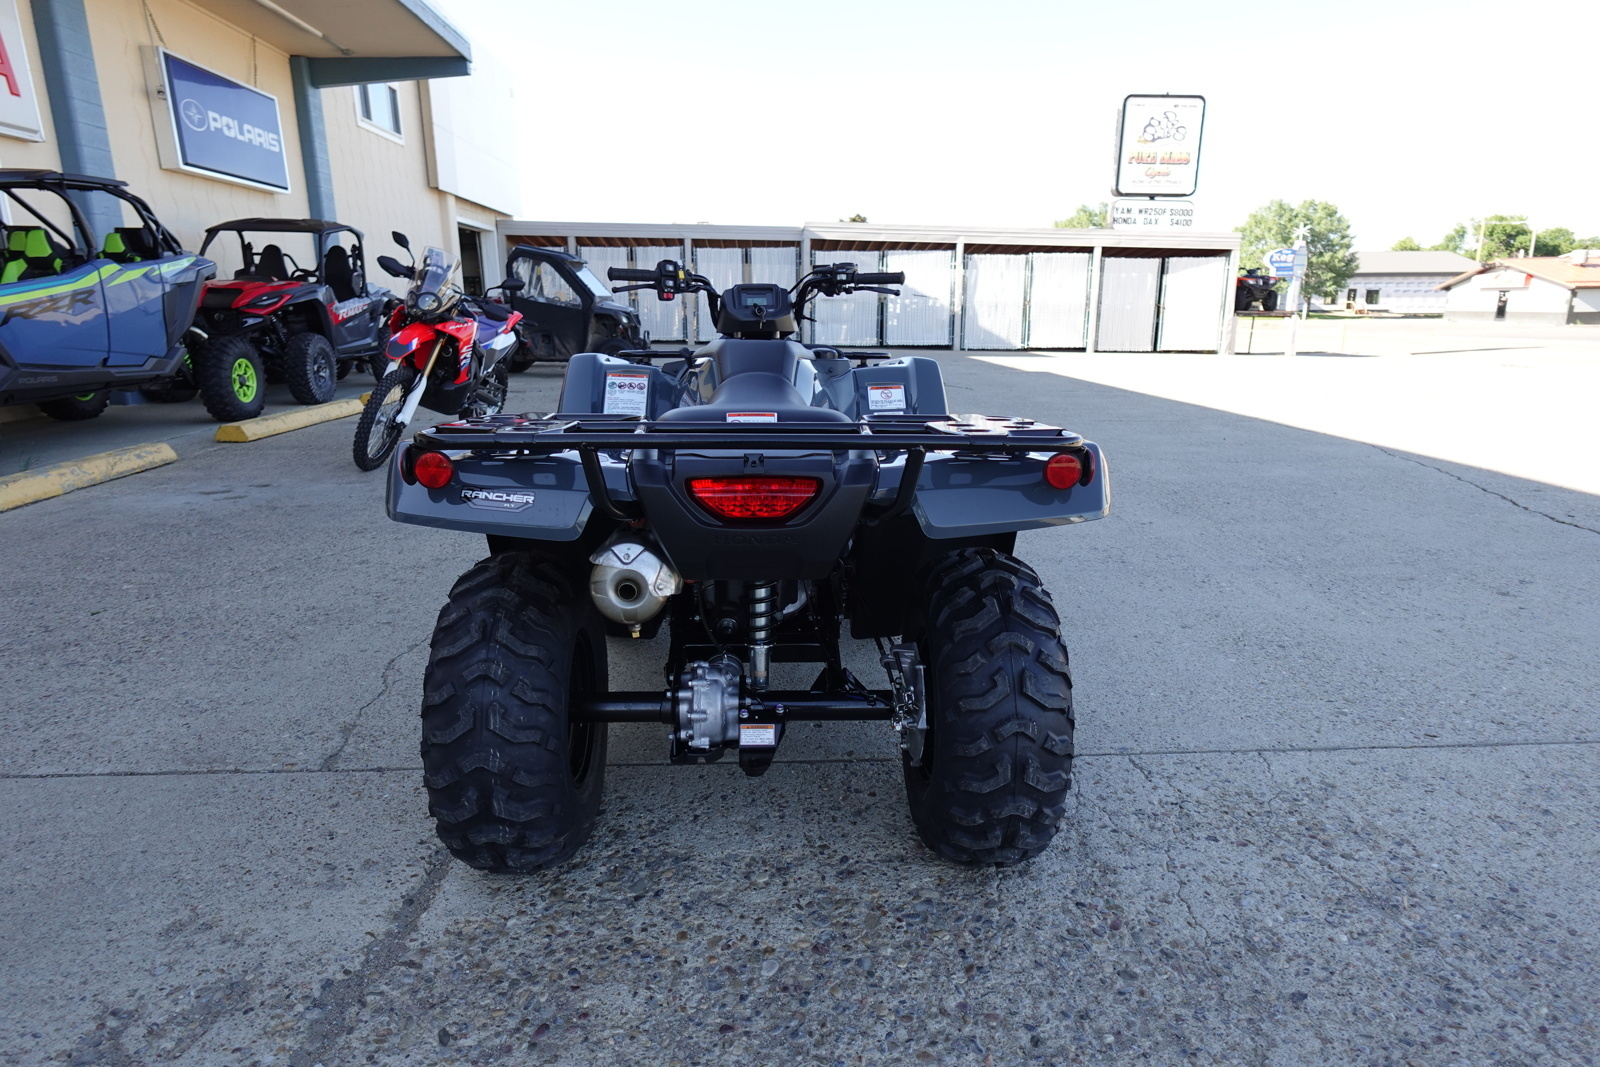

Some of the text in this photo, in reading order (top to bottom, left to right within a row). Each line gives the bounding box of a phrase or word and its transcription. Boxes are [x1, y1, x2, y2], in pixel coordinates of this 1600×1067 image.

[207, 110, 280, 153] POLARIS
[1113, 217, 1137, 225] HONDA
[1143, 217, 1159, 226] DAX
[1271, 253, 1295, 263] Keg
[0, 288, 96, 327] RZR
[448, 322, 473, 330] RALLY
[18, 375, 58, 385] POLARIS
[461, 489, 535, 504] RANCHER
[712, 534, 799, 545] HONDA
